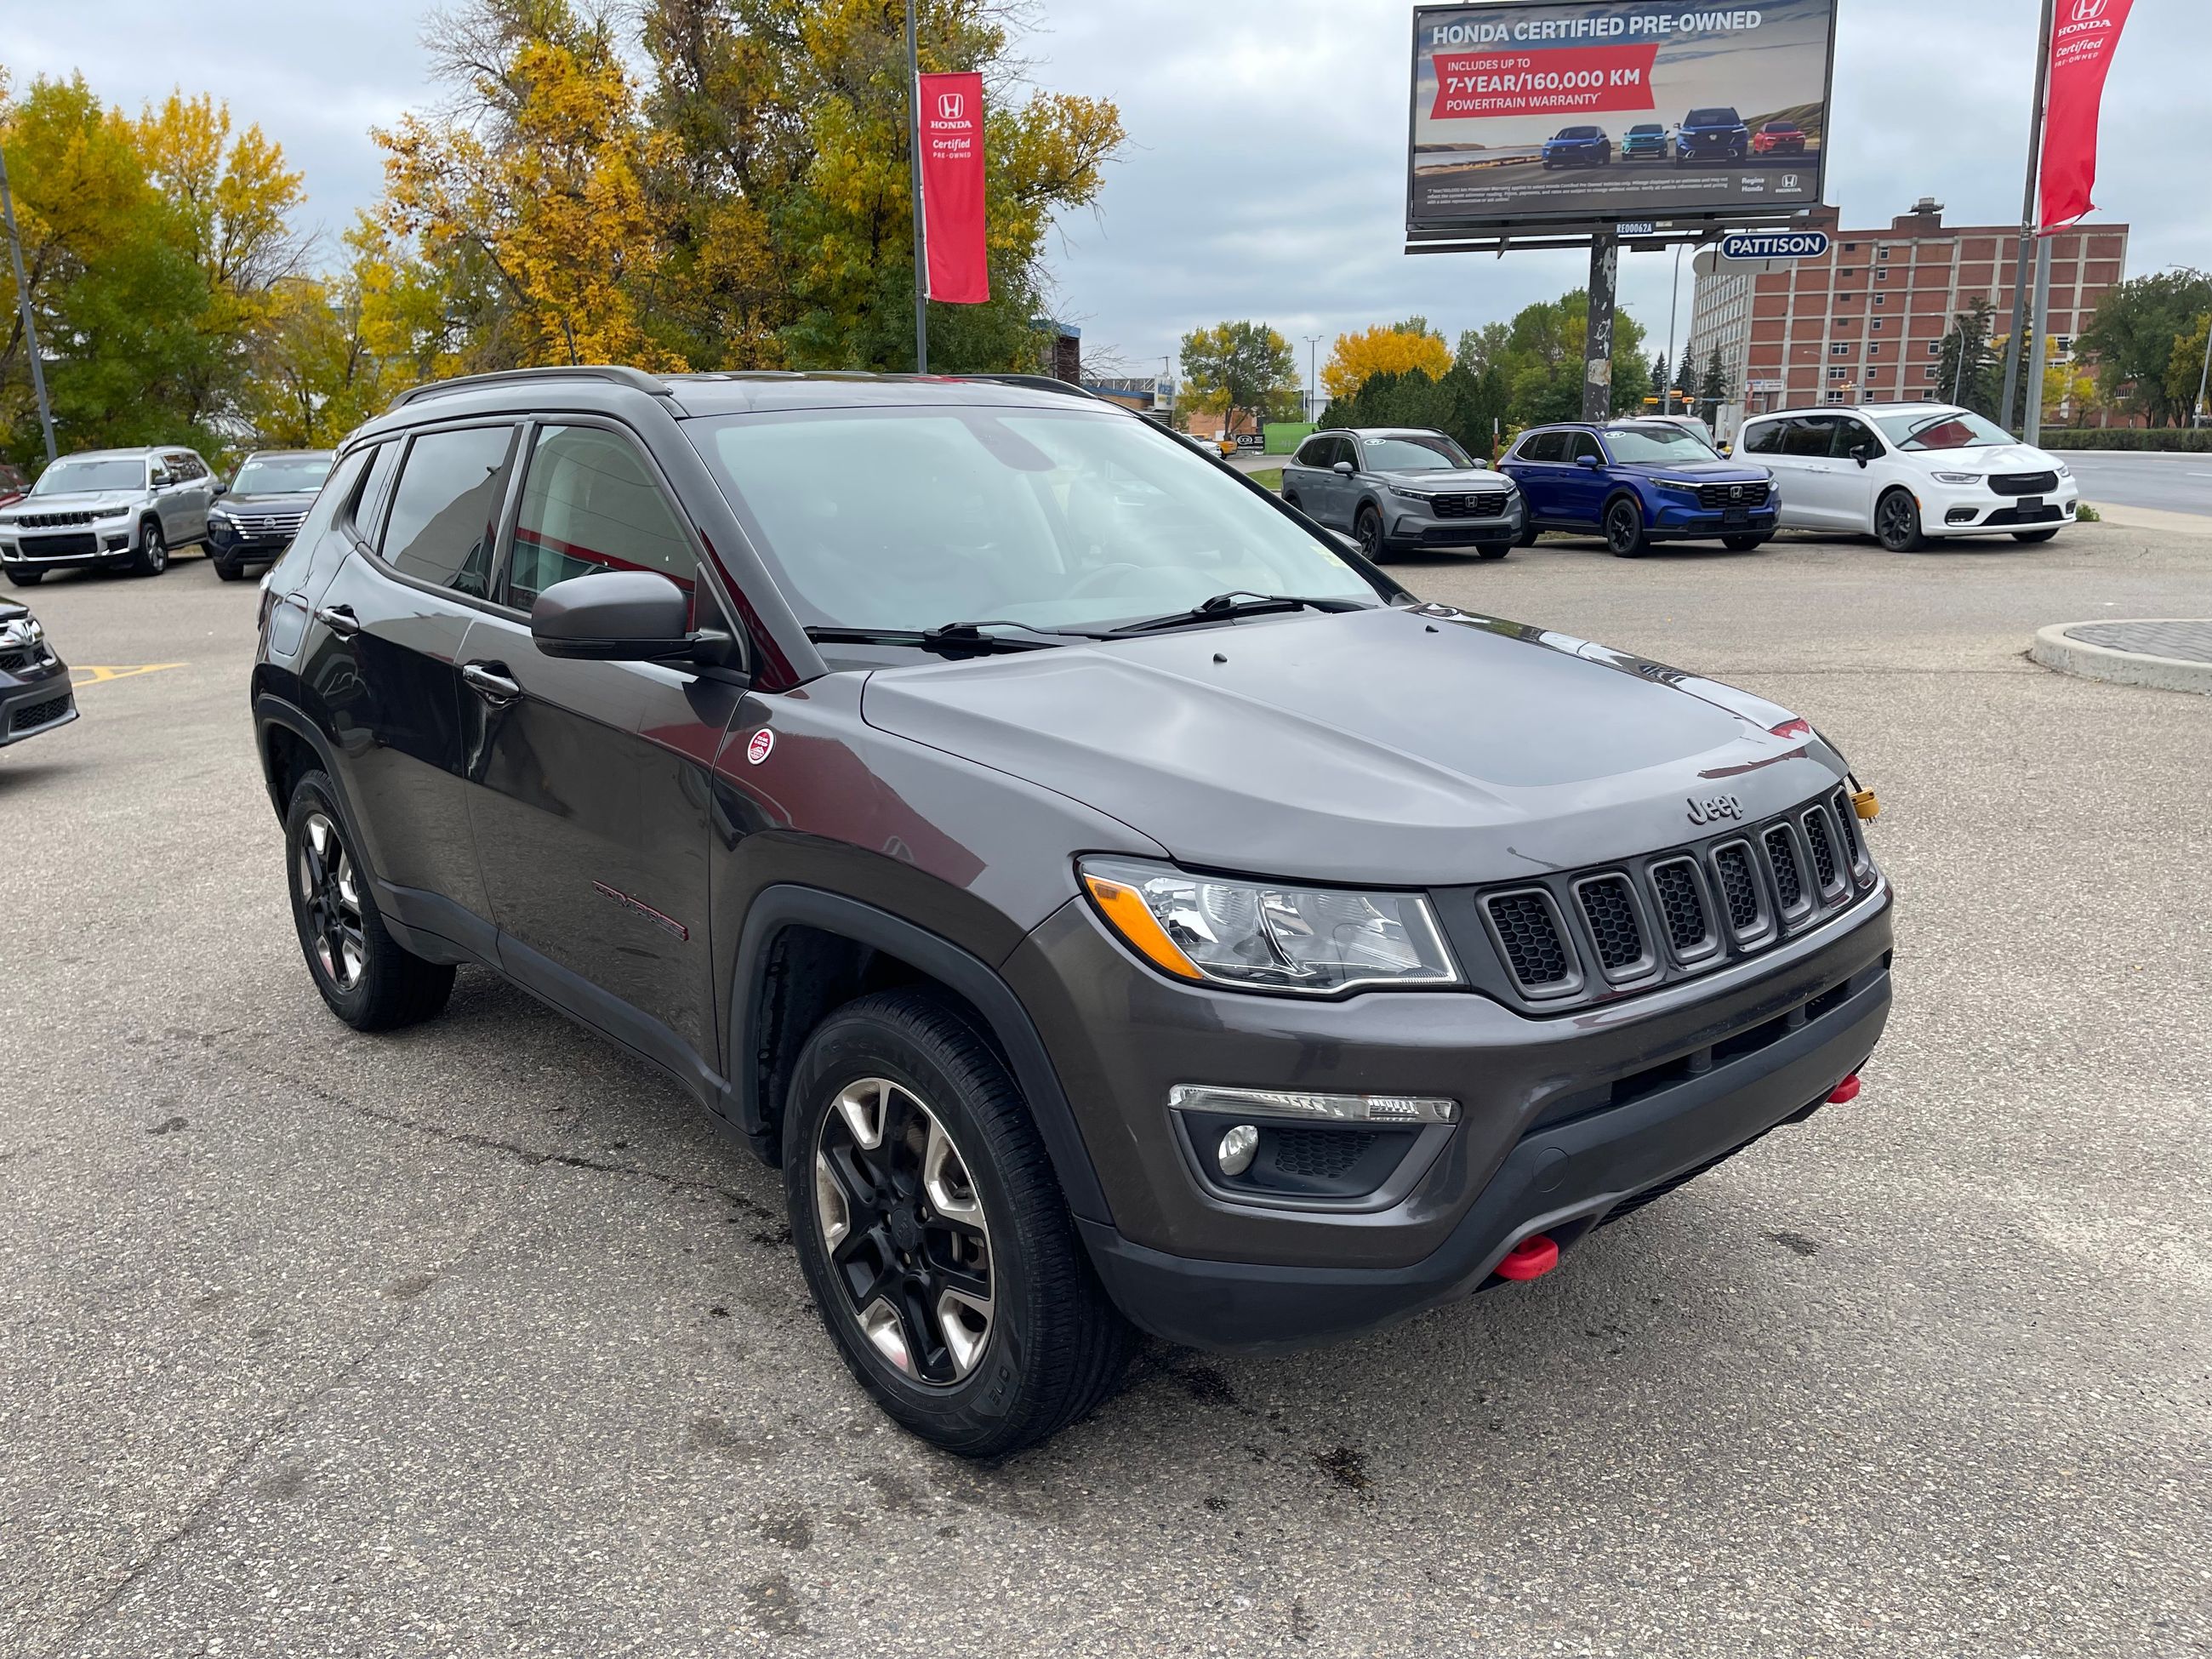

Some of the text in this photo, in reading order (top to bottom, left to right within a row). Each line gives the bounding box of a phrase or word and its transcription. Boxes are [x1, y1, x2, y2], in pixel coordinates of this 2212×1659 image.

[1433, 10, 1762, 44] HONDA CERTIFIED PRE-OWNED
[2057, 19, 2112, 37] HONDA
[2055, 37, 2104, 58] Certified
[1447, 58, 1531, 71] INCLUDES UP TO
[1446, 68, 1640, 94] 7-YEAR/160,000 KM
[1446, 96, 1525, 111] POWERTRAIN
[930, 120, 972, 129] HONDA
[932, 138, 971, 151] Certified
[1616, 223, 1652, 235] RE00062A
[1729, 237, 1821, 255] PATTISON
[1687, 793, 1744, 825] Jeep
